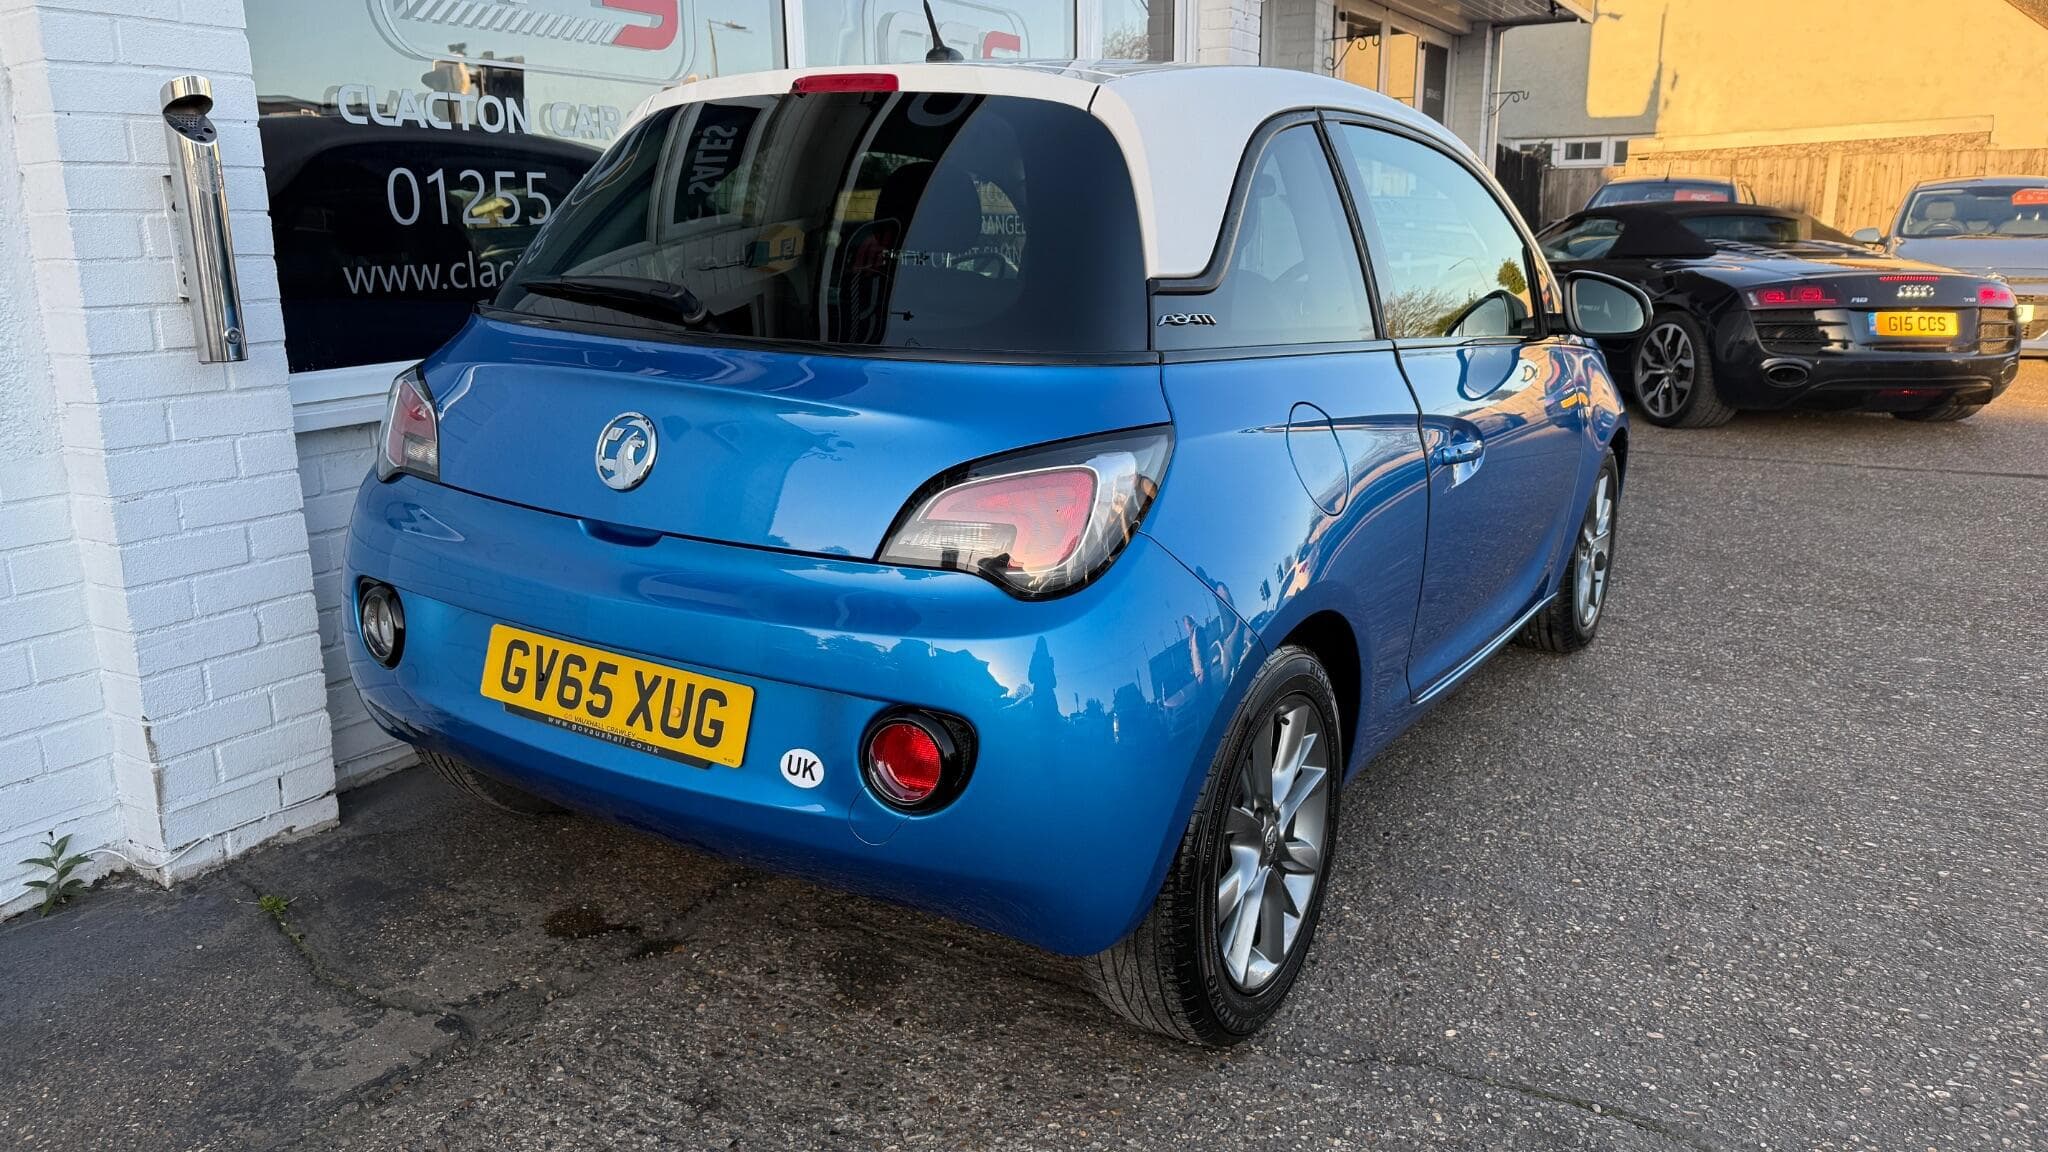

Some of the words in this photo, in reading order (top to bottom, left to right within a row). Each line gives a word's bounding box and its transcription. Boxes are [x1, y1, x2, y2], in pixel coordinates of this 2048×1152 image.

[337, 84, 532, 135] CLACTON
[550, 102, 621, 140] CAR
[387, 167, 551, 226] 01255
[343, 251, 520, 294] www.clac
[1918, 316, 1946, 331] CCS
[501, 639, 619, 719] GV65
[626, 670, 728, 748] XUG
[548, 717, 660, 754] www.govauxhall.co.uk
[574, 715, 605, 730] VAUXHALL
[606, 725, 636, 738] CRAWLEY
[787, 754, 817, 781] UK
